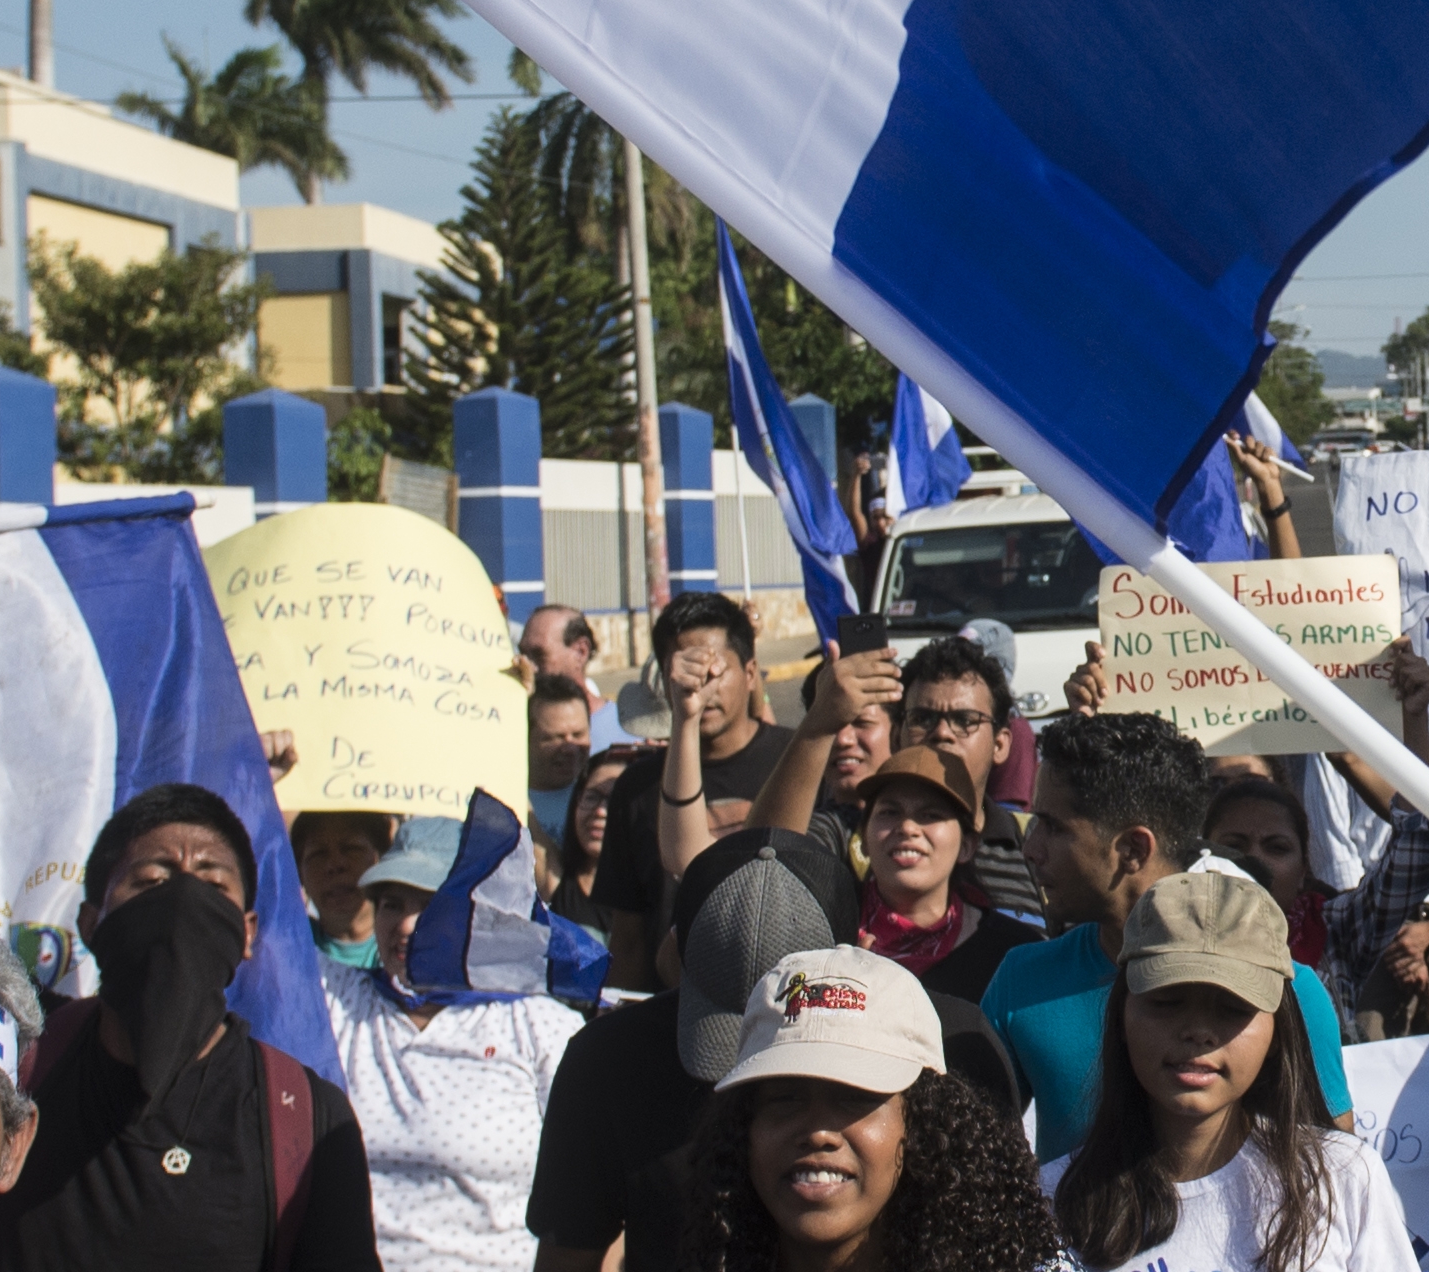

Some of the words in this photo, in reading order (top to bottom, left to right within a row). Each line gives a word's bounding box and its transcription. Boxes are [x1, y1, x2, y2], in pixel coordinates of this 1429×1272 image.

[1366, 491, 1419, 521] NO
[226, 564, 293, 596] QUE
[316, 559, 367, 585] SE
[387, 565, 444, 593] VAN
[1231, 573, 1385, 607] Estudiantes
[303, 642, 323, 667] Y
[1113, 631, 1153, 658] NO
[1301, 623, 1394, 645] ARMAS
[263, 682, 300, 703] LA
[1116, 670, 1154, 694] NO
[1166, 664, 1249, 692] SOMOS
